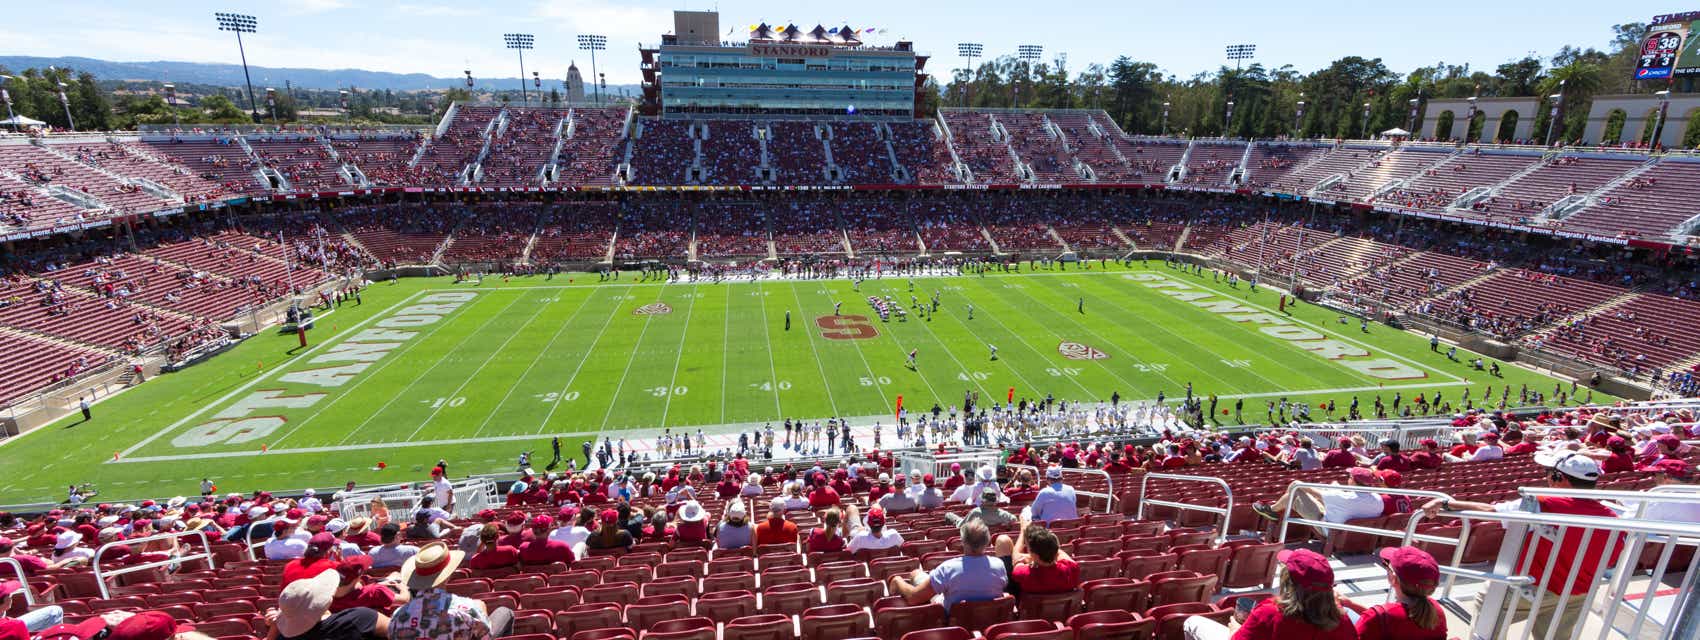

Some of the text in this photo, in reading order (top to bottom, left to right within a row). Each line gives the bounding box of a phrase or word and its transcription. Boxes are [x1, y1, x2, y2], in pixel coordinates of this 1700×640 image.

[1659, 37, 1679, 49] 38
[752, 46, 829, 57] STANFORD
[1643, 58, 1670, 67] 2 3
[7, 232, 31, 240] leading
[53, 224, 80, 233] Congrats!
[1510, 224, 1531, 232] leading
[1554, 229, 1586, 240] Congrats!
[1586, 234, 1628, 246] #gostanford
[814, 314, 881, 340] S
[1121, 272, 1429, 380] STANFORD
[170, 290, 481, 448] STANFORD
[1046, 368, 1079, 376] 30
[1133, 364, 1166, 372] 20
[859, 376, 892, 386] 50
[958, 372, 987, 381] 40
[652, 386, 688, 397] 30
[760, 380, 792, 392] 40
[430, 397, 467, 408] 10
[542, 392, 580, 402] 20
[410, 617, 418, 628] S
